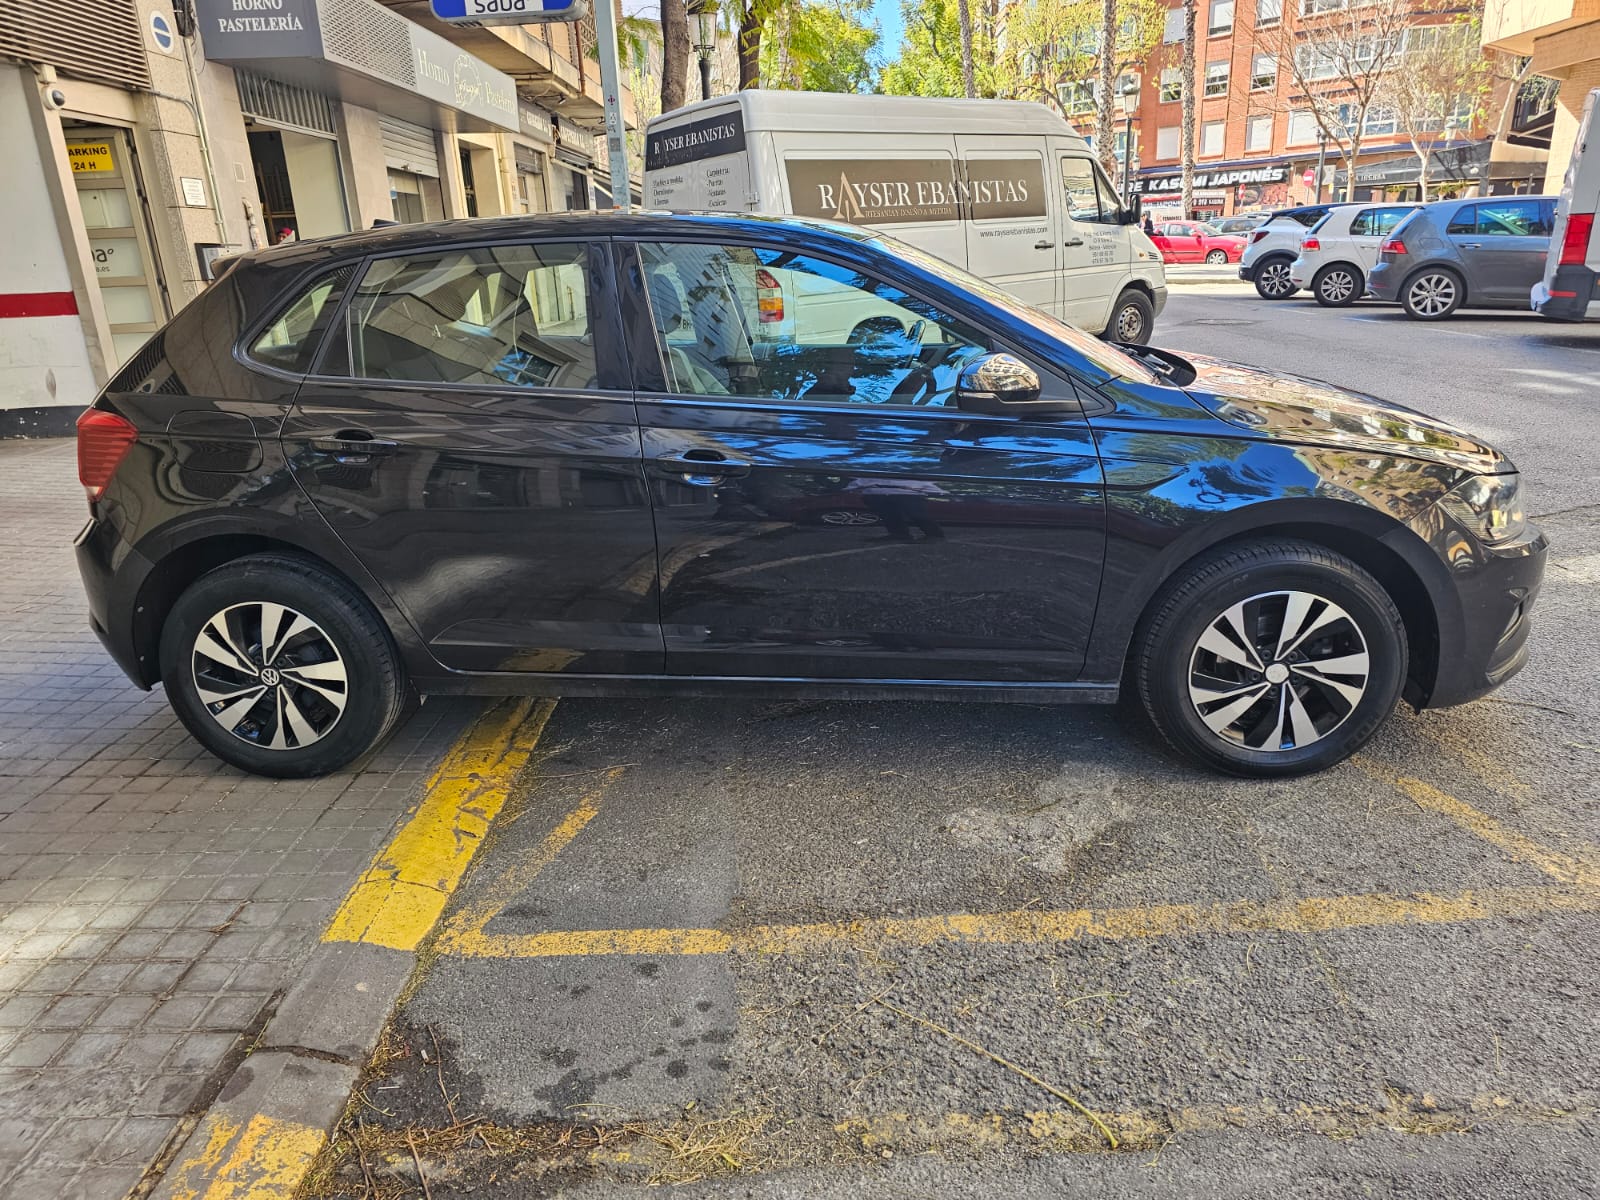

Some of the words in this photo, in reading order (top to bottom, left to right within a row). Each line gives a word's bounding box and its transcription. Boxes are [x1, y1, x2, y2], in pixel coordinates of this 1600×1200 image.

[232, 0, 283, 11] HORNO
[218, 12, 304, 33] PASTELERÍA
[654, 136, 685, 155] RYSER
[685, 122, 736, 147] EBANISTAS
[67, 146, 108, 157] ARKING
[73, 161, 86, 171] 24
[88, 161, 97, 170] H
[1208, 166, 1284, 186] JAPONÉS
[817, 171, 912, 222] RAYSER
[915, 179, 1029, 206] EBANISTAS
